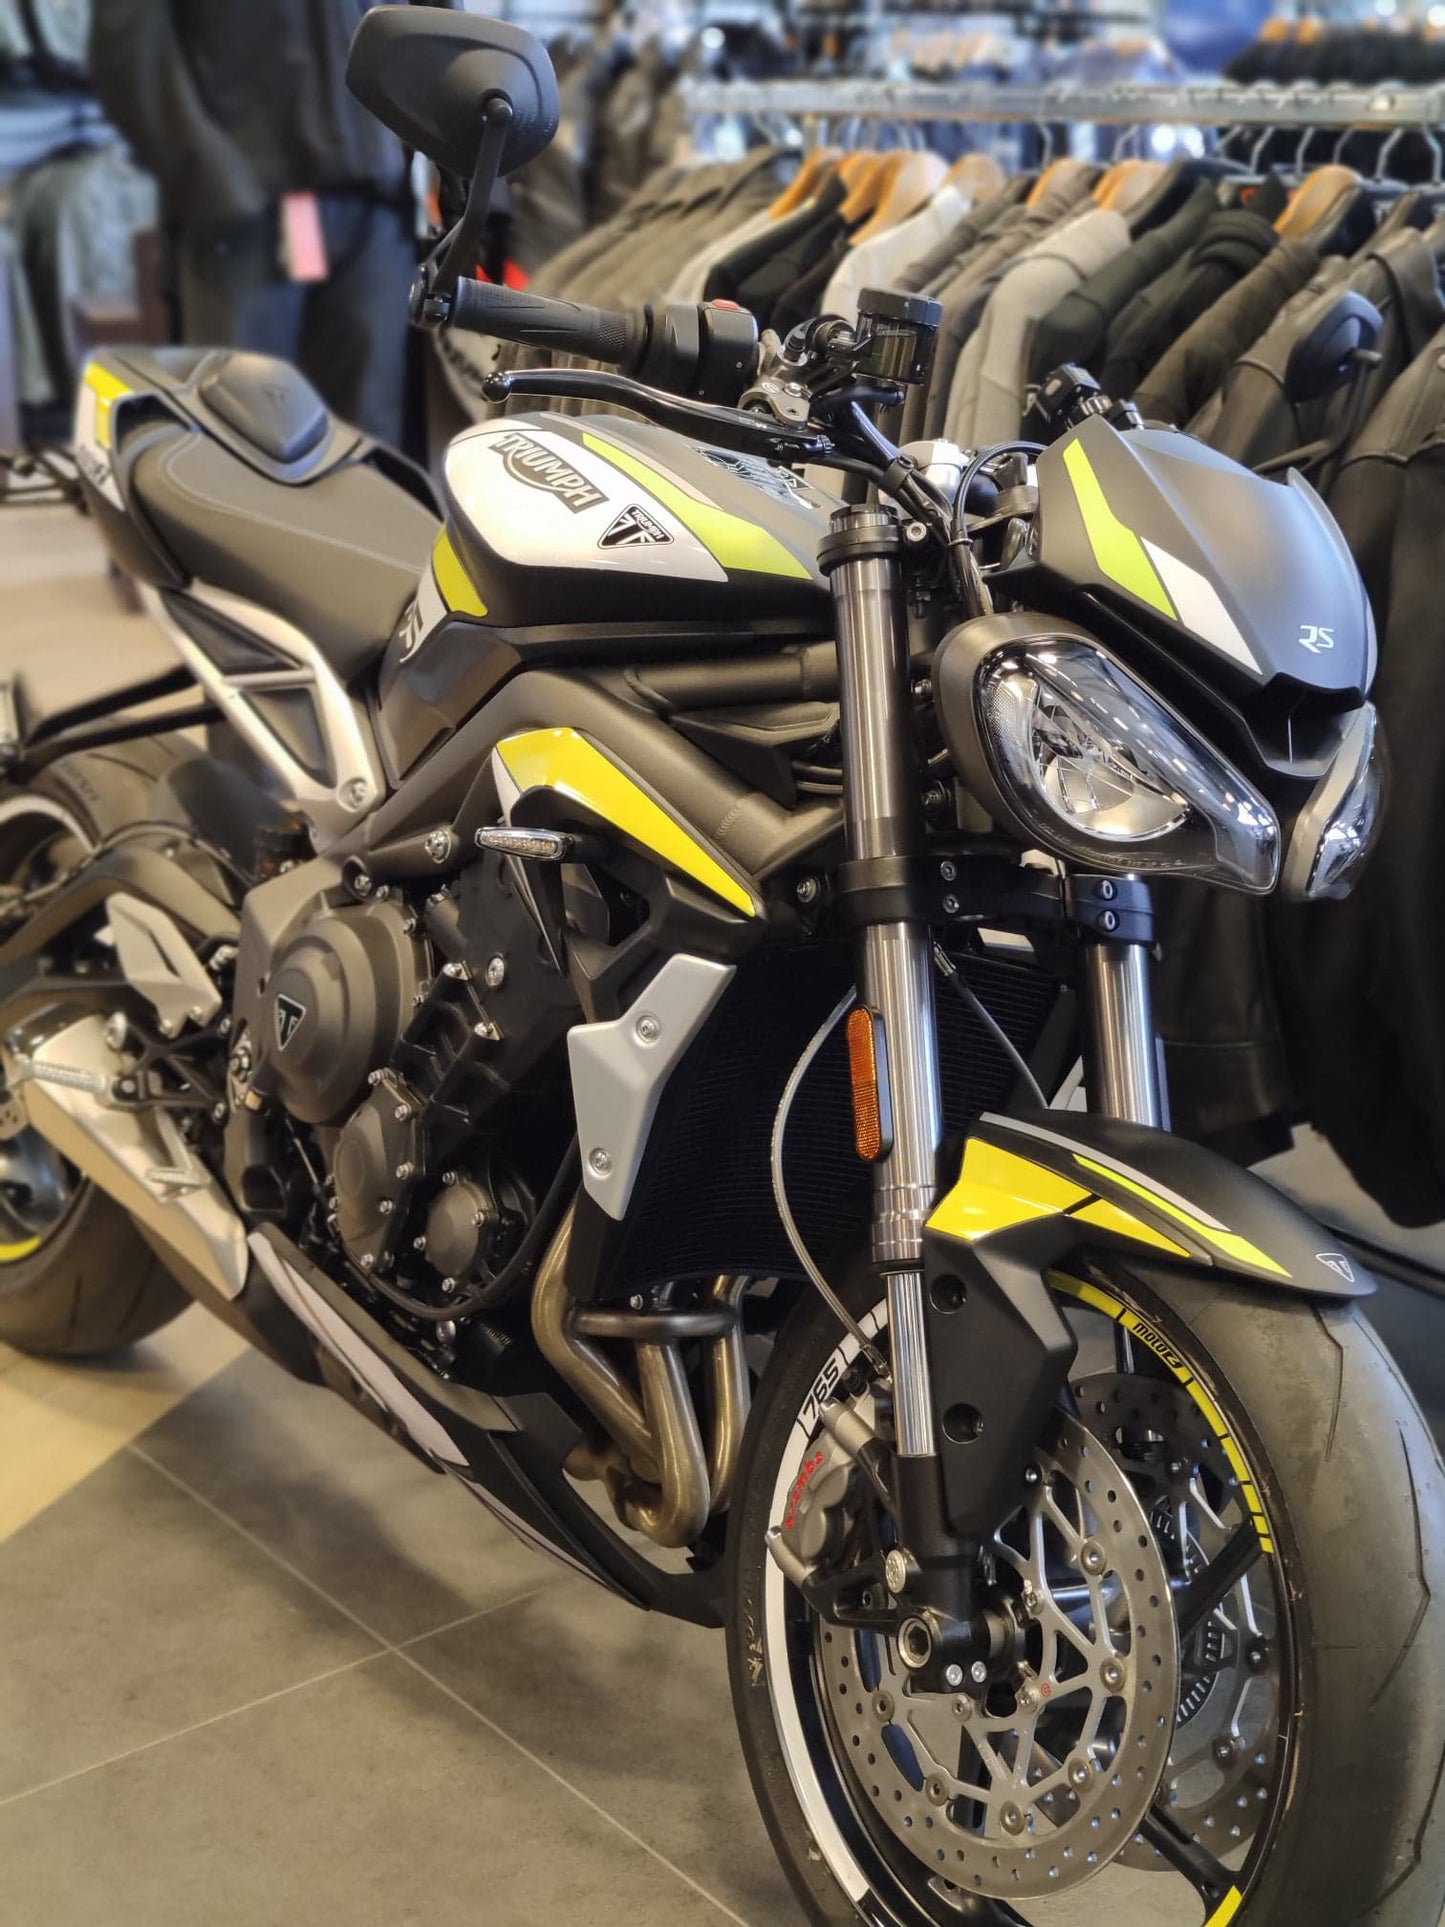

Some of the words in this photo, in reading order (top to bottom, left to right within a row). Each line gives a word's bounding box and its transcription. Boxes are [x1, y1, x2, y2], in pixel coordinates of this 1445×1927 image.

[493, 432, 602, 509] TRIUMPH
[630, 508, 666, 540] TRIUMPH
[1298, 624, 1335, 654] RS
[802, 1356, 839, 1421] 765
